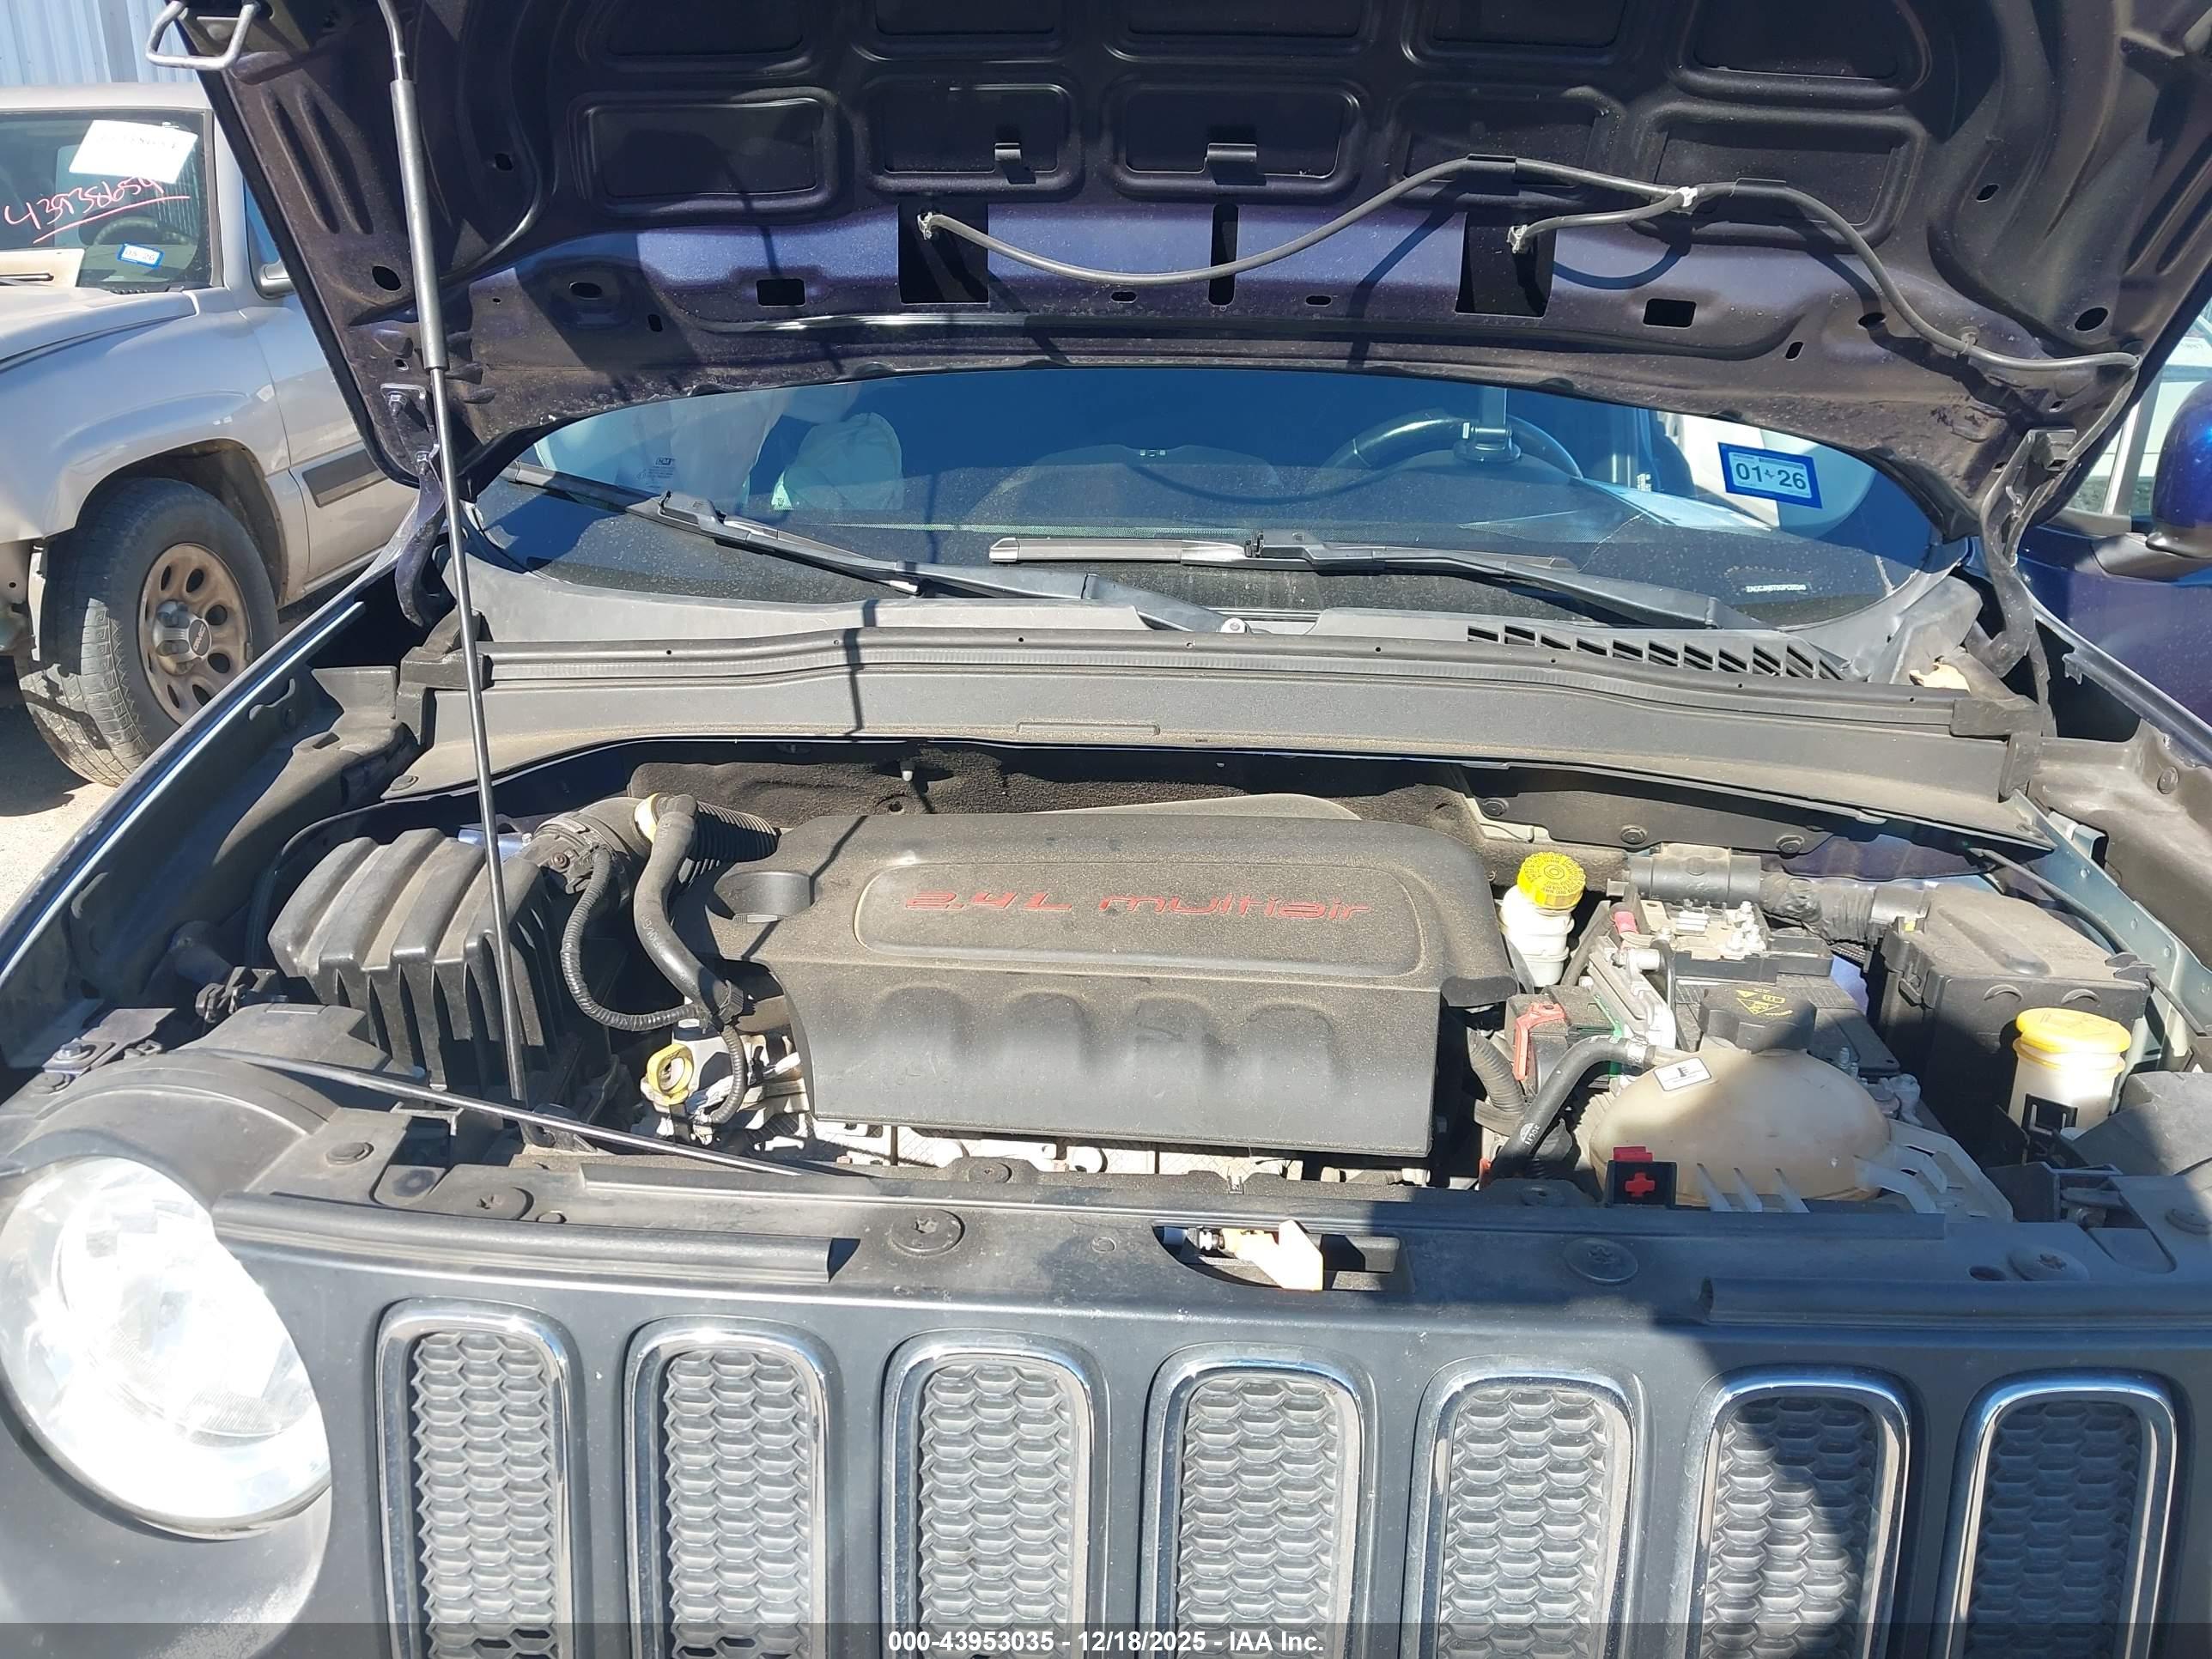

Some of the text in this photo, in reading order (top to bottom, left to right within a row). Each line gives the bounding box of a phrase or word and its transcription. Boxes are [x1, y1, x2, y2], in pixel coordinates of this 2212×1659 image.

[1735, 462, 1807, 490] 01 26
[192, 623, 207, 652] GMC
[1098, 893, 1370, 920] multiair
